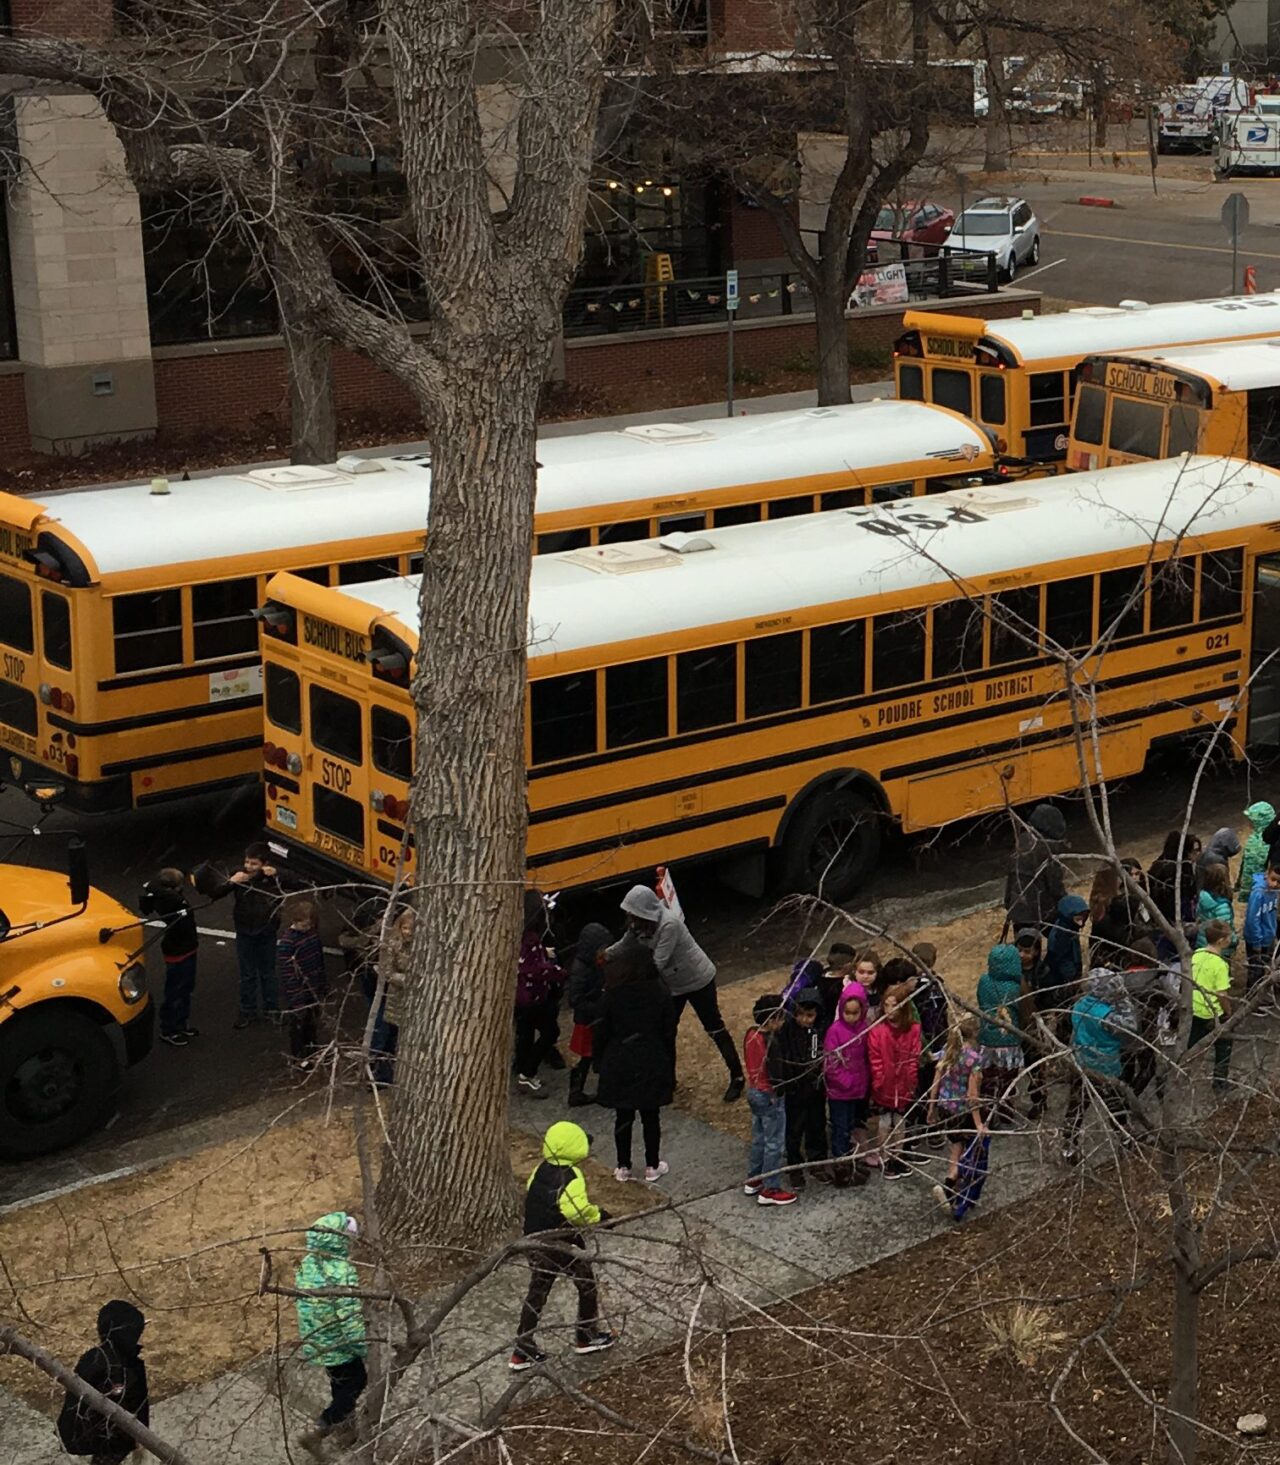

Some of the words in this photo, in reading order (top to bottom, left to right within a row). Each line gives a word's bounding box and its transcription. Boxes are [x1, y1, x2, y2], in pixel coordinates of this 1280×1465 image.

[877, 269, 904, 281] LIGHT
[927, 336, 957, 357] SCHOOL
[959, 340, 976, 359] BUS
[1109, 367, 1148, 393] SCHOOL
[1153, 376, 1174, 397] BUS
[304, 615, 343, 656] SCHOOL
[1206, 633, 1230, 651] 021
[4, 653, 25, 683] STOP
[878, 699, 922, 727] POUDRE
[933, 688, 974, 714] SCHOOL
[985, 675, 1034, 702] DISTRICT
[322, 758, 351, 793] STOP
